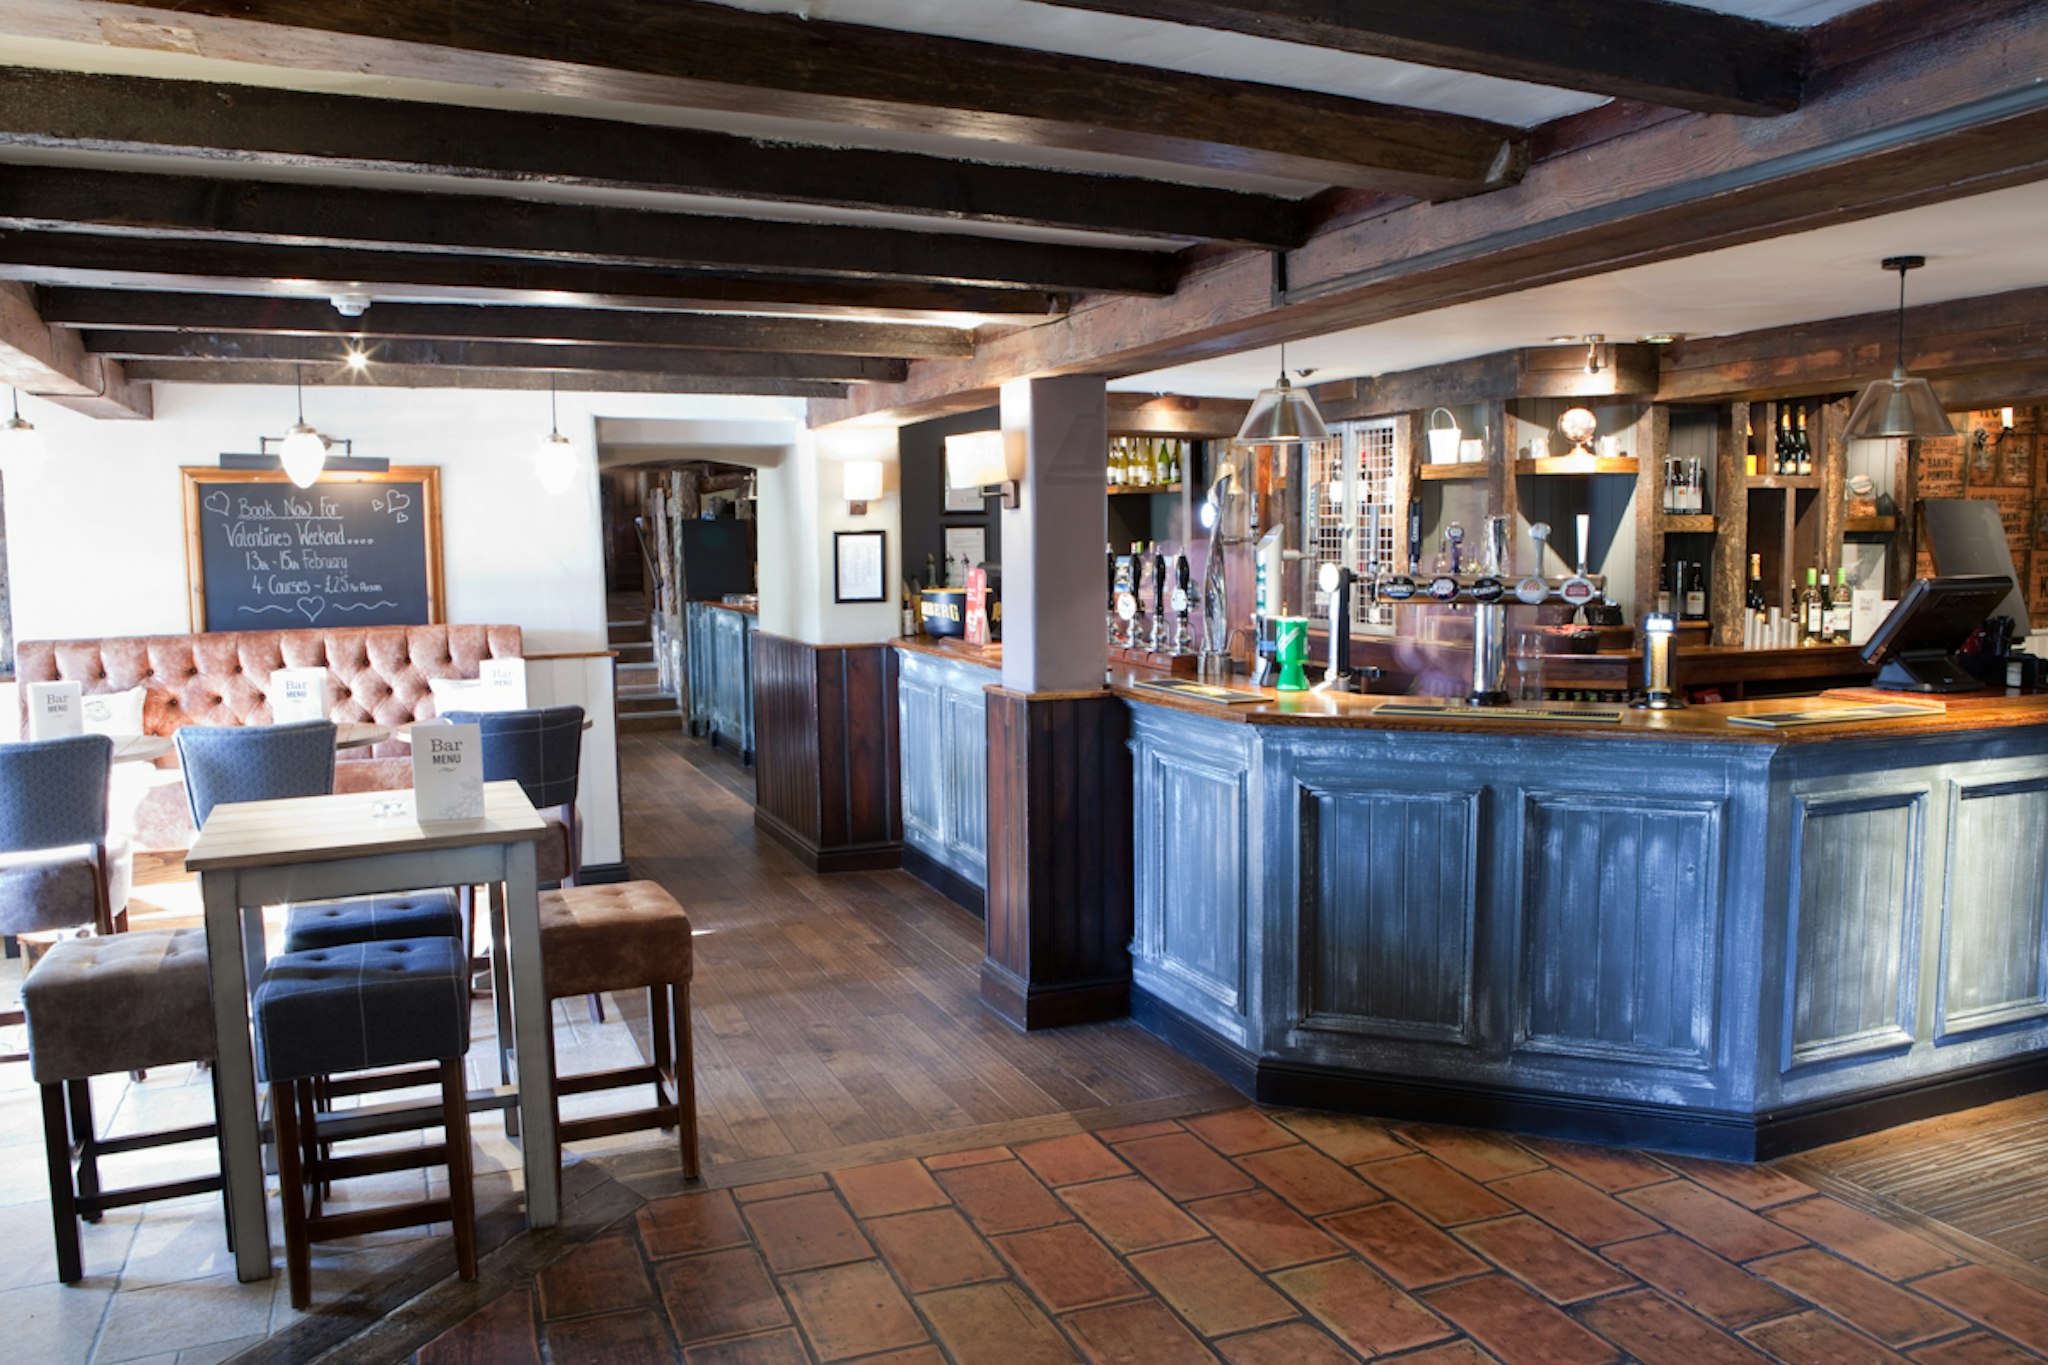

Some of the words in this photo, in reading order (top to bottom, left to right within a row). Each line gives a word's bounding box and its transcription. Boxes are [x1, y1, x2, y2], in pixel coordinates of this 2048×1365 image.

[1928, 458, 1953, 467] BAKING
[1928, 471, 1953, 481] POWDER
[238, 497, 276, 516] Book
[283, 496, 313, 516] Now
[320, 496, 340, 516] For
[222, 521, 292, 547] Valentines
[302, 549, 348, 573] February
[252, 575, 263, 595] 4
[268, 574, 311, 595] Courses
[324, 575, 350, 594] £25
[285, 680, 308, 690] Bar
[46, 694, 69, 705] Bar
[47, 705, 69, 713] MENU
[430, 738, 464, 753] Bar
[432, 754, 462, 765] MENU
